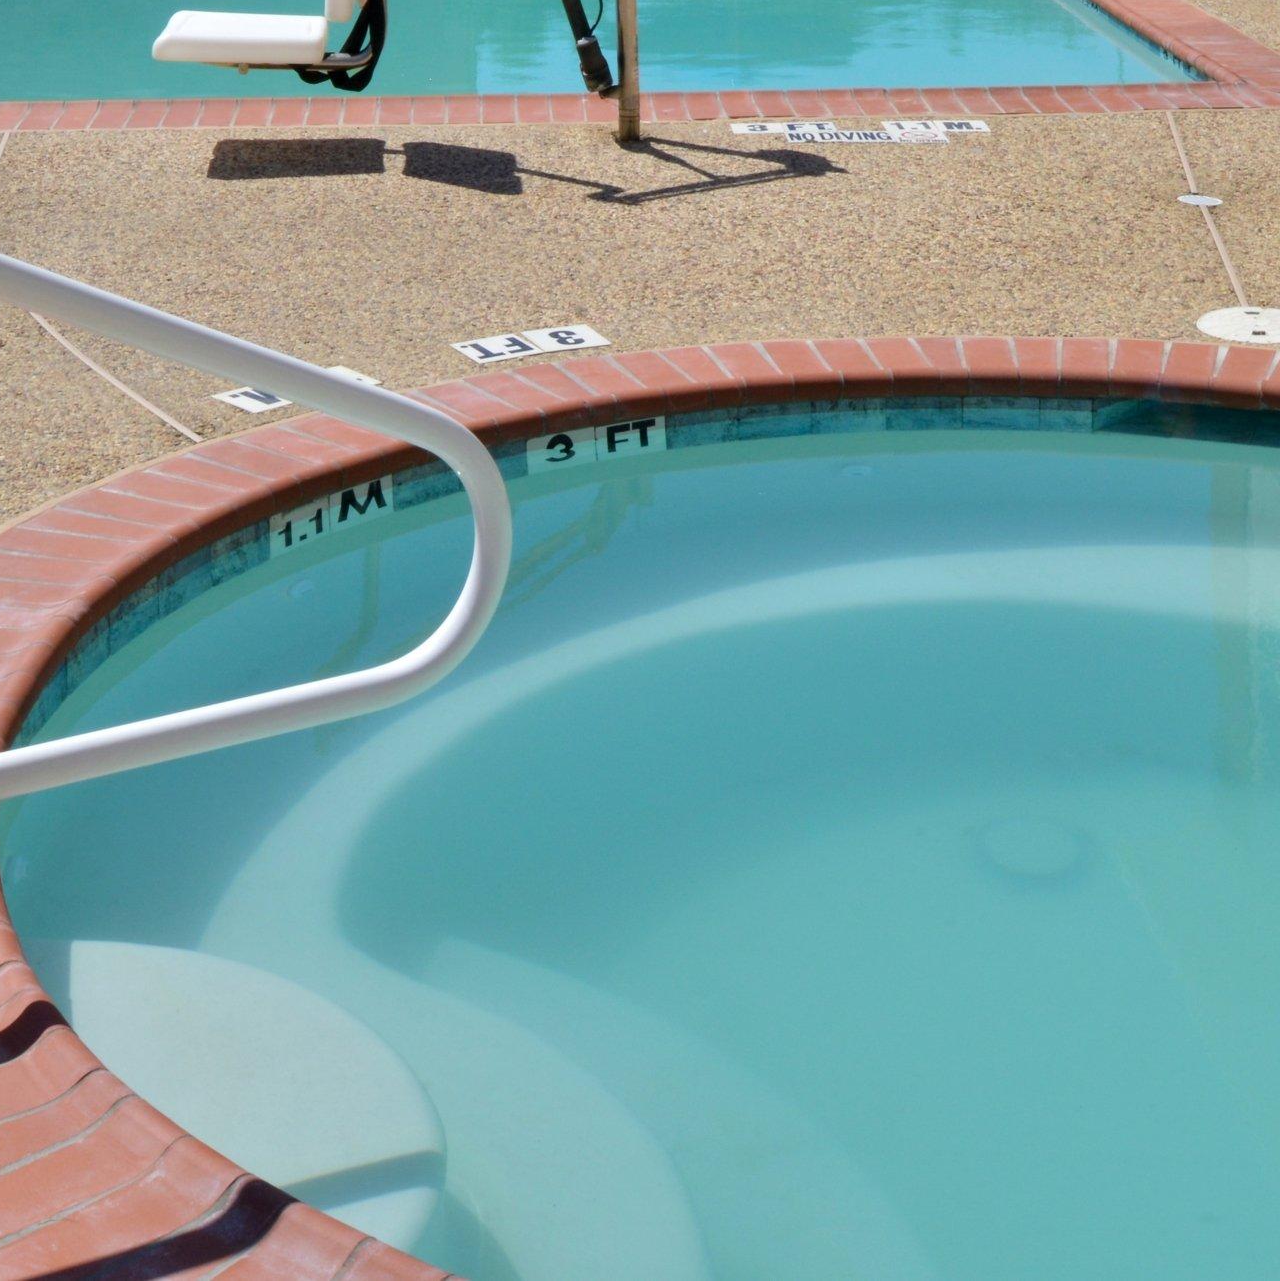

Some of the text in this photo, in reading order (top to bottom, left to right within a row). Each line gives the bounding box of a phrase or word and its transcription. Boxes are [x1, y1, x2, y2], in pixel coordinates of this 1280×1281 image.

[747, 124, 768, 132] 3
[890, 122, 932, 130] 1.1
[942, 122, 982, 130] M.
[788, 131, 893, 141] NO DIVING
[460, 330, 585, 359] 3 FT.
[546, 418, 656, 462] 3 FT
[278, 480, 387, 547] 1.1 M
